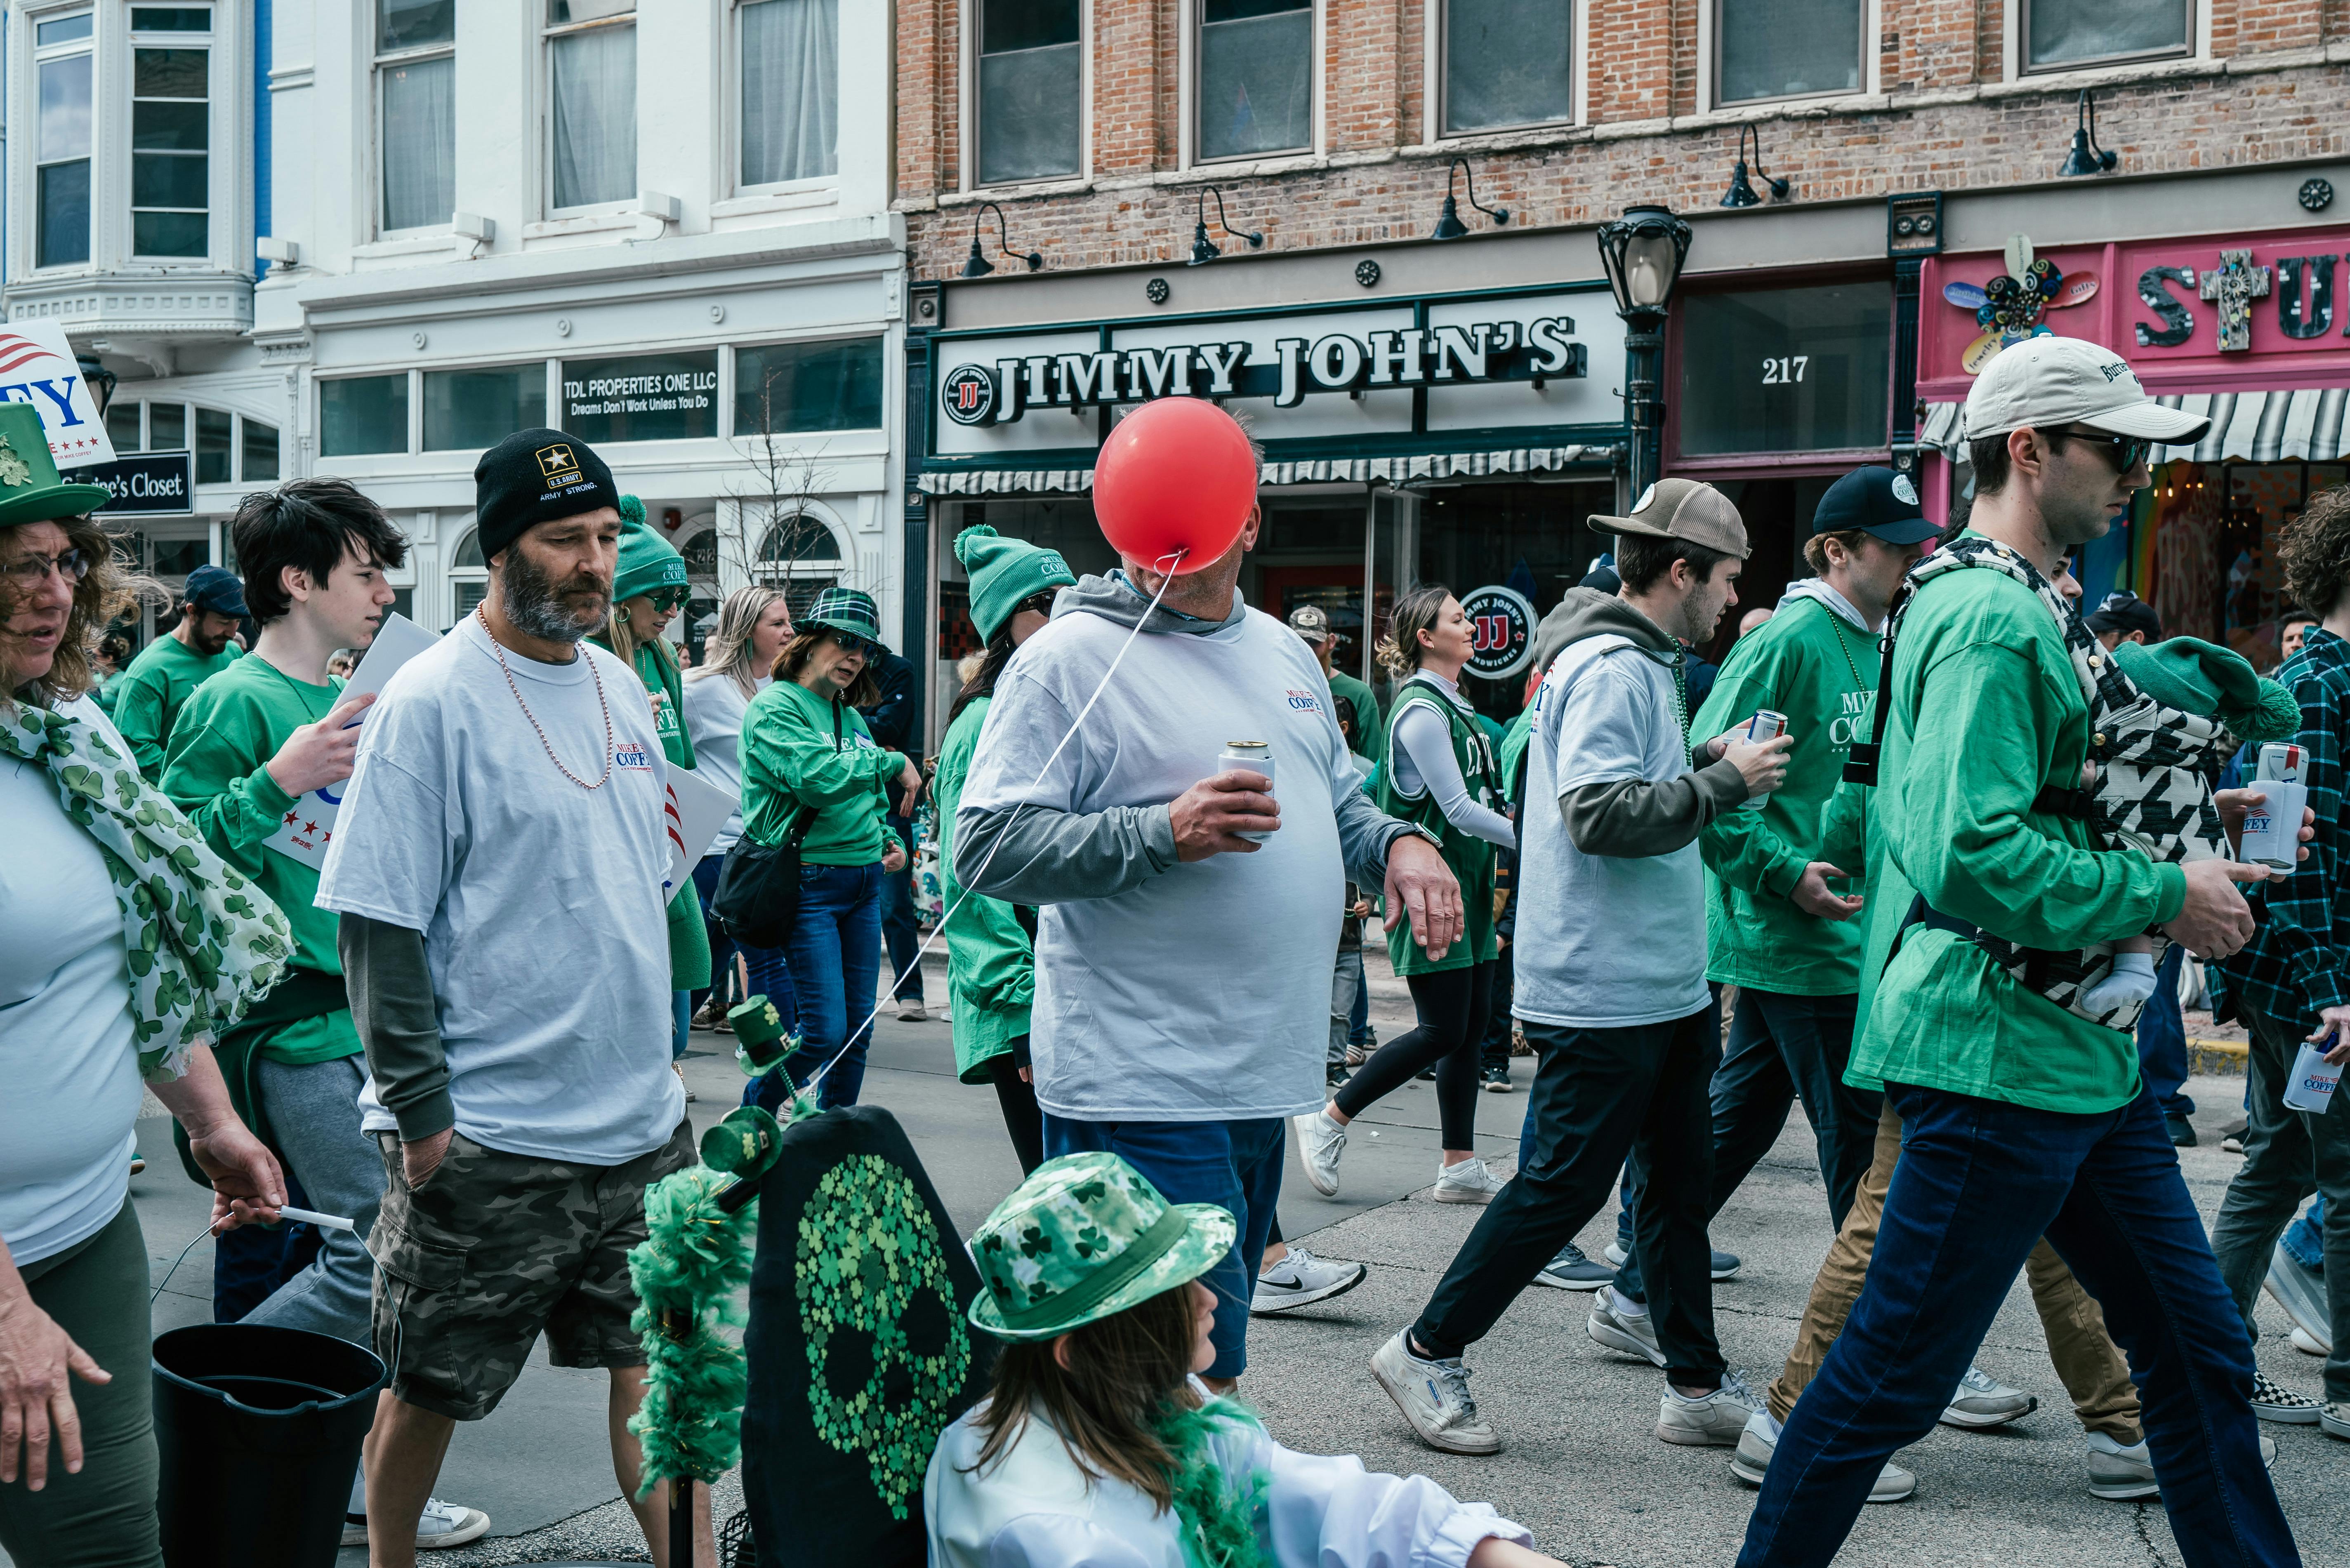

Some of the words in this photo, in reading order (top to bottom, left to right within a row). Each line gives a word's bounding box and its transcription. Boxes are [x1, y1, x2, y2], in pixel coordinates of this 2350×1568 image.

[2070, 281, 2096, 296] Gifts
[1968, 336, 1998, 370] Jewelry
[996, 343, 1252, 422] JIMMY
[1275, 317, 1574, 407] JOHN'S
[1762, 356, 1808, 384] 217
[564, 381, 586, 399] TDL
[589, 375, 661, 397] PROPERTIES
[664, 373, 690, 392] ONE
[693, 371, 716, 390] LLC
[571, 403, 601, 416] Dreams
[603, 400, 625, 414] Don't
[627, 399, 647, 412] Work
[649, 398, 676, 411] Unless
[678, 396, 694, 409] You
[695, 395, 708, 407] Do
[958, 382, 979, 409] JJ
[131, 472, 183, 497] Closet
[540, 491, 561, 501] ARMY
[566, 482, 597, 494] STRONG.
[1897, 488, 1913, 496] COFF
[1465, 598, 1489, 620] MMY
[1492, 598, 1523, 626] JOHN'S
[1474, 614, 1509, 651] JJ
[1470, 647, 1518, 667] NDWICHES
[616, 743, 639, 753] MIKE
[616, 753, 651, 766] COFF
[2244, 818, 2271, 830] FEY
[2304, 1079, 2336, 1091] COFFE
[2310, 1074, 2329, 1083] MIKE
[1427, 1381, 1439, 1401] Reebok
